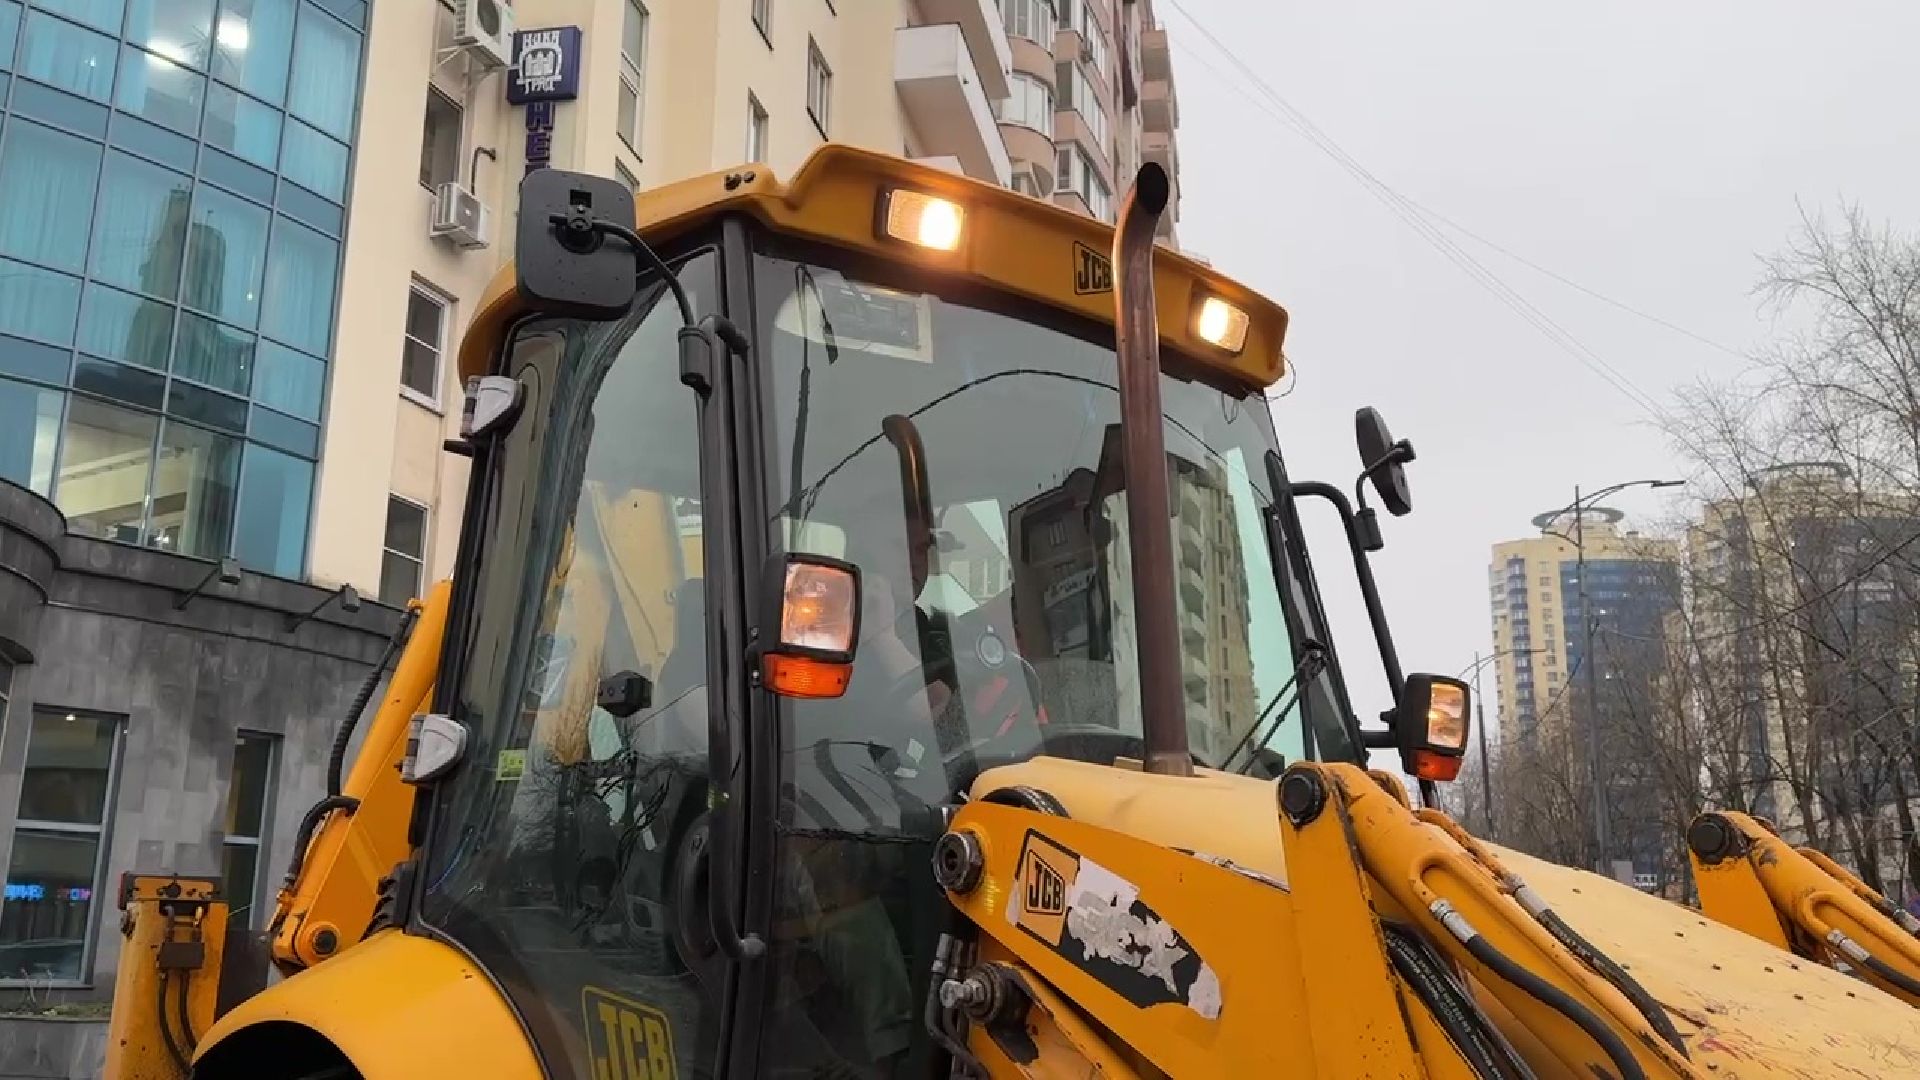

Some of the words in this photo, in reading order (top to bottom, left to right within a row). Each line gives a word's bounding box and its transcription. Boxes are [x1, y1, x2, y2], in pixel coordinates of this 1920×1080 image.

[1078, 249, 1112, 289] JCB
[1029, 860, 1061, 910] JCB
[597, 1001, 671, 1080] JCB
